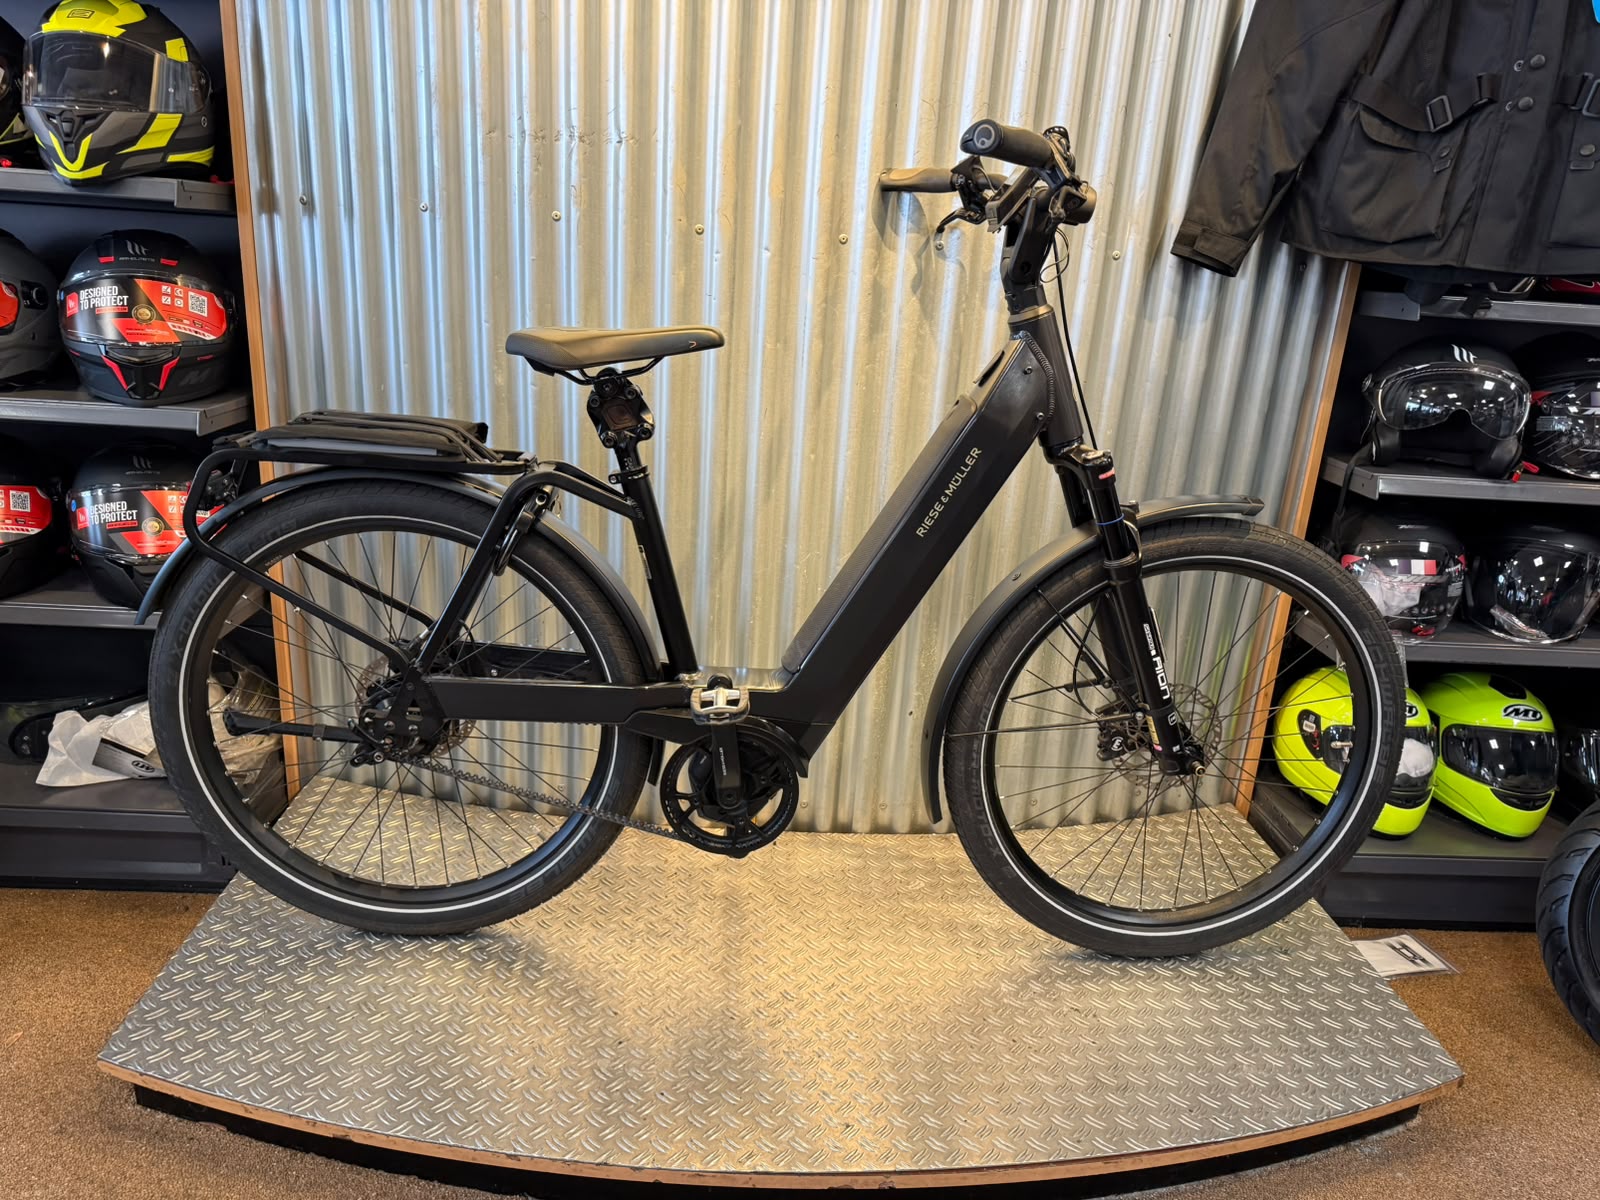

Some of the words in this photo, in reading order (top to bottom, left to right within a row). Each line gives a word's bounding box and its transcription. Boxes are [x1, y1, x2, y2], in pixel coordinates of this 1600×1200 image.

[80, 286, 118, 300] DESIGNED
[80, 299, 89, 310] TO
[90, 295, 129, 309] PROTECT
[944, 447, 982, 496] MÜLLER
[941, 495, 949, 503] &
[90, 501, 127, 515] DESIGNED
[91, 515, 99, 525] TO
[101, 510, 138, 524] PROTECT
[916, 502, 945, 537] RIESE
